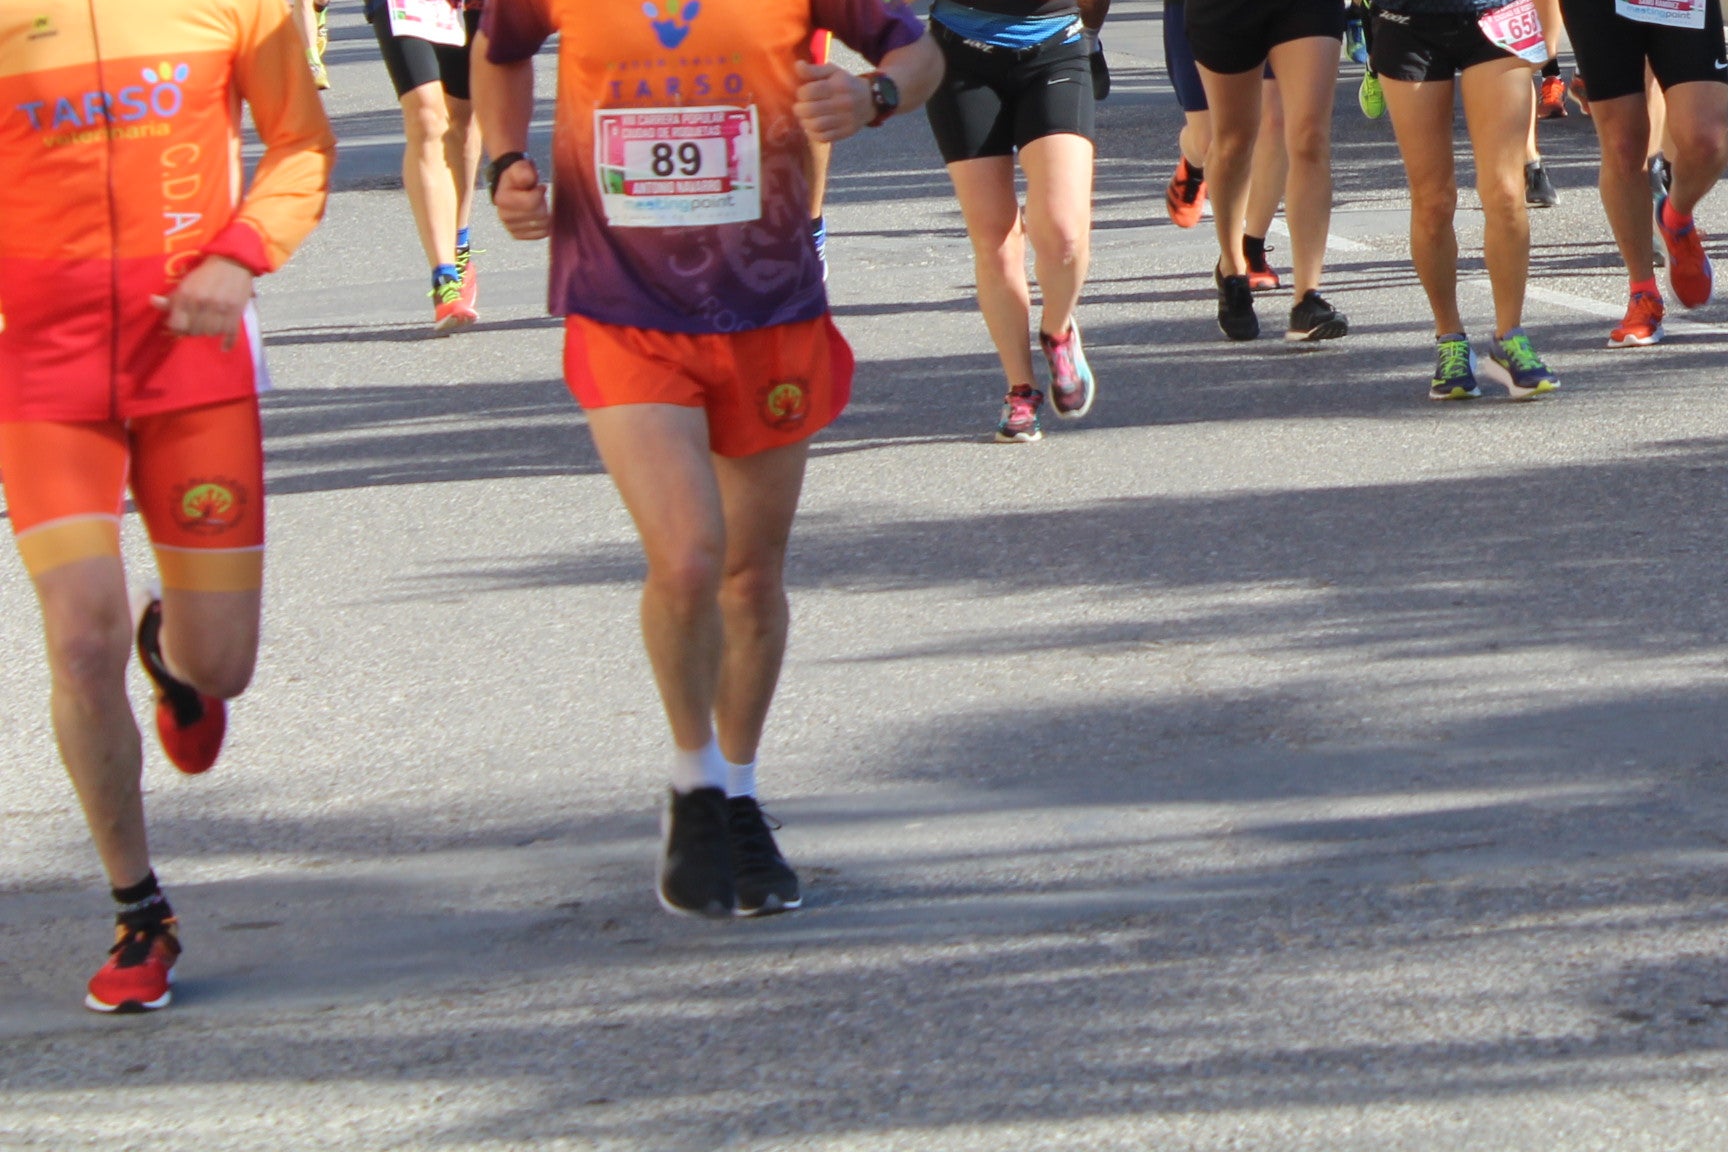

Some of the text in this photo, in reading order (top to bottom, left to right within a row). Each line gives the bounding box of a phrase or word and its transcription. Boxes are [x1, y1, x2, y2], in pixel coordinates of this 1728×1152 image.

[609, 73, 744, 99] TARSO
[16, 82, 184, 130] TARSO
[637, 113, 681, 125] CARRERA
[681, 111, 726, 123] POPULAR
[621, 127, 656, 139] CIUDAD
[656, 126, 670, 138] DE
[651, 142, 702, 177] 89
[632, 181, 675, 195] ANTONIO
